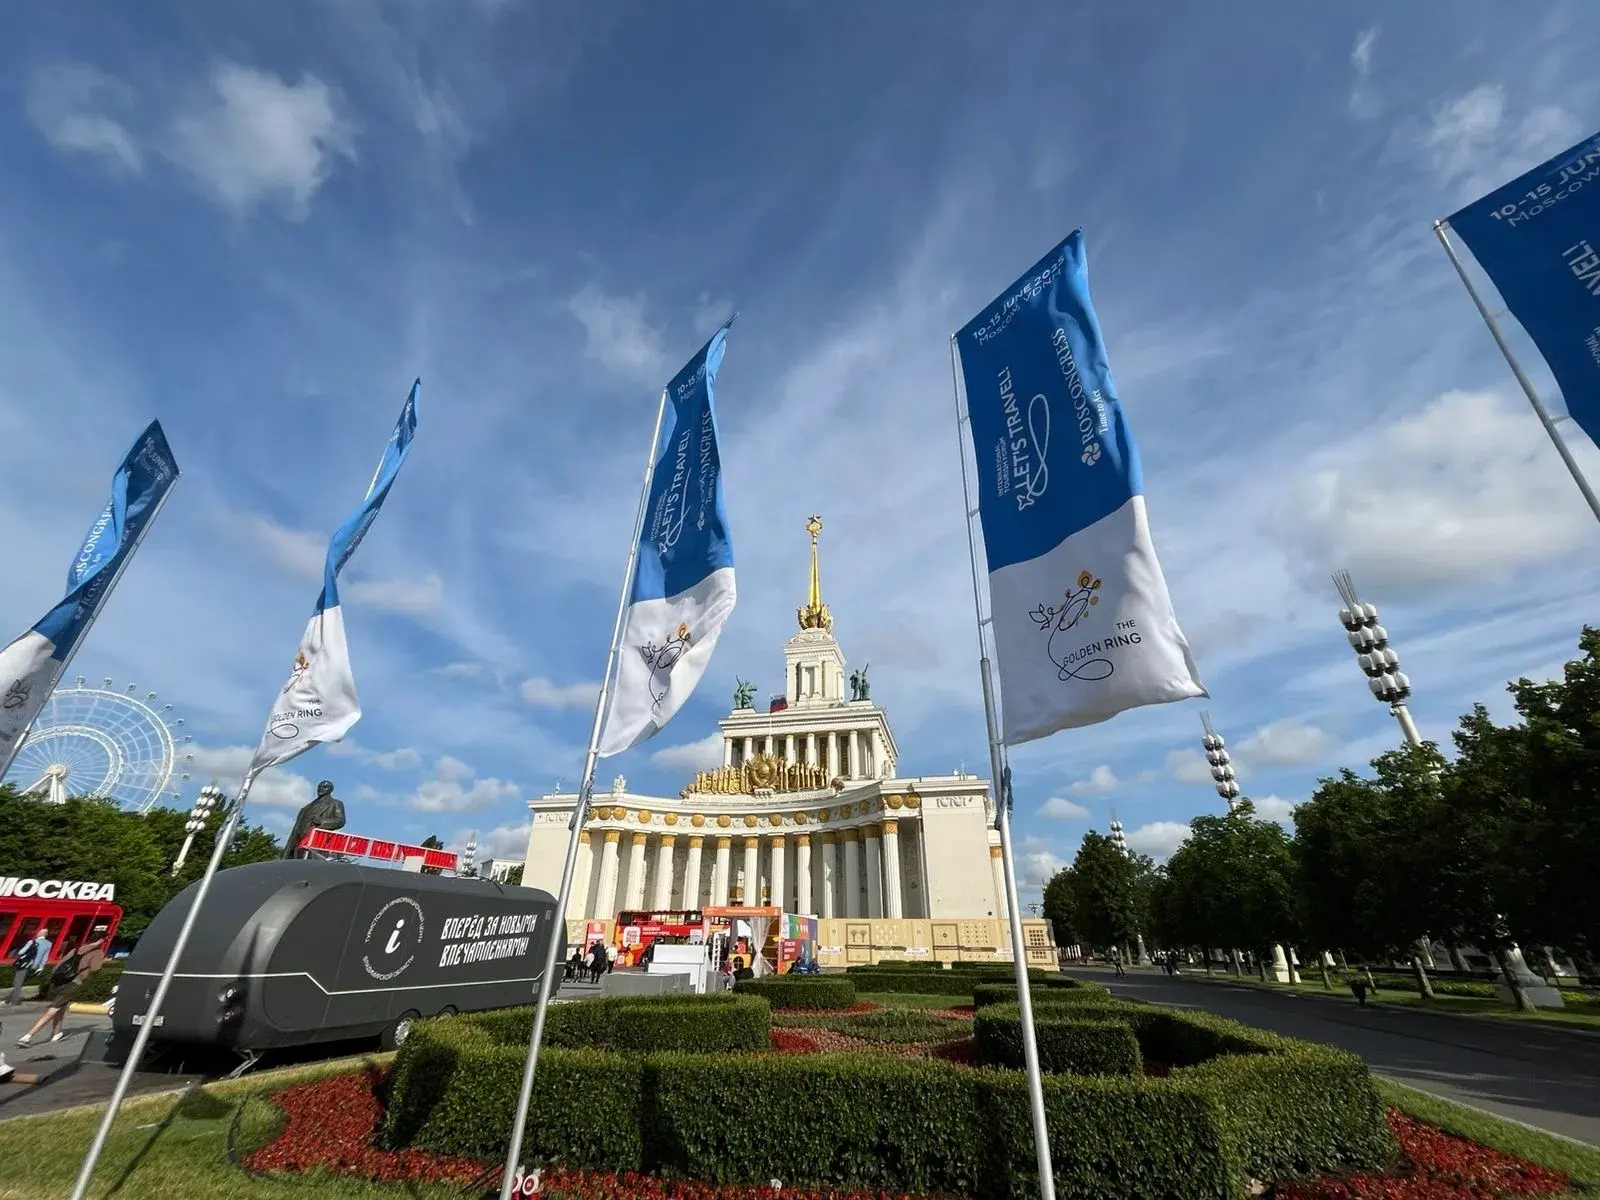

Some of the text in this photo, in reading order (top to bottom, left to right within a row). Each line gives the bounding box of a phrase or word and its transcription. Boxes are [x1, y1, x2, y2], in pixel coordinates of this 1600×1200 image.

[1490, 183, 1552, 220] 10-15
[973, 312, 1001, 340] 10-15
[1003, 283, 1033, 316] JUNE
[1051, 328, 1094, 445] ROSCONGRESS
[997, 366, 1030, 490] LET'S TRAVEL!
[660, 494, 680, 538] LET'S
[671, 428, 691, 491] TRAVEL!
[1115, 619, 1136, 631] THE
[1062, 632, 1142, 666] GOLDEN RING
[297, 708, 323, 718] RING
[0, 876, 116, 902] МОСКВА
[440, 914, 538, 939] ВПЕРЁД ЗА НОВЫМИ
[439, 937, 530, 967] ВПЕЧАТЛЕНИЯМИ!
